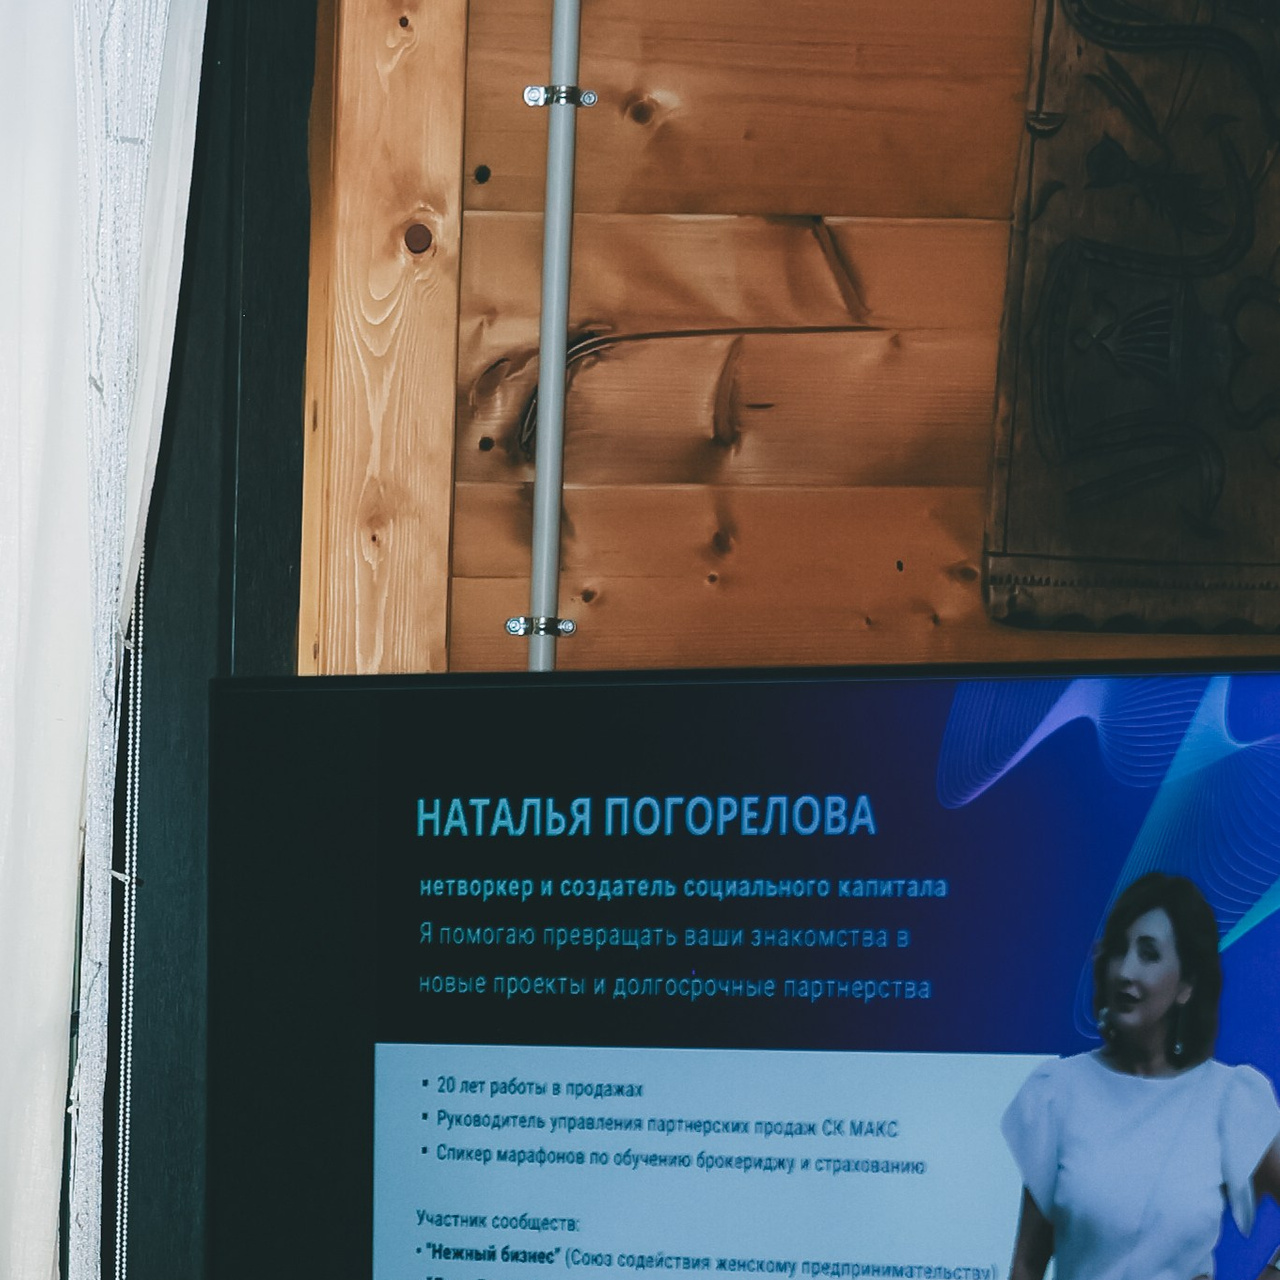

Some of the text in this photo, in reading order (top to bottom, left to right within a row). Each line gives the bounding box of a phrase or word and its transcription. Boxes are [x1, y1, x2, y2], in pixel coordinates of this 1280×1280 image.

[418, 795, 876, 836] НАТАЛЬЯ ПОГОРЕЛОВА
[420, 879, 948, 900] нетворкер и создатель социального капитала
[420, 922, 909, 951] Я помогаю превращать ваши знакомства в
[420, 975, 931, 1002] новые проекты и долгосрочные партнерства
[438, 1076, 642, 1099] 20 лет работы в продажах
[437, 1109, 898, 1137] Руководитель управления партнерских продаж СК МАКС
[437, 1143, 926, 1176] Спикер марафонов по обучению брокериджу и страхованию
[416, 1209, 580, 1233] Участник сообществ:
[426, 1242, 496, 1262] "Нежный
[501, 1245, 561, 1264] бизнес"
[565, 1248, 612, 1269] (Союз
[617, 1251, 710, 1271] содействия
[716, 1257, 797, 1278] женскому
